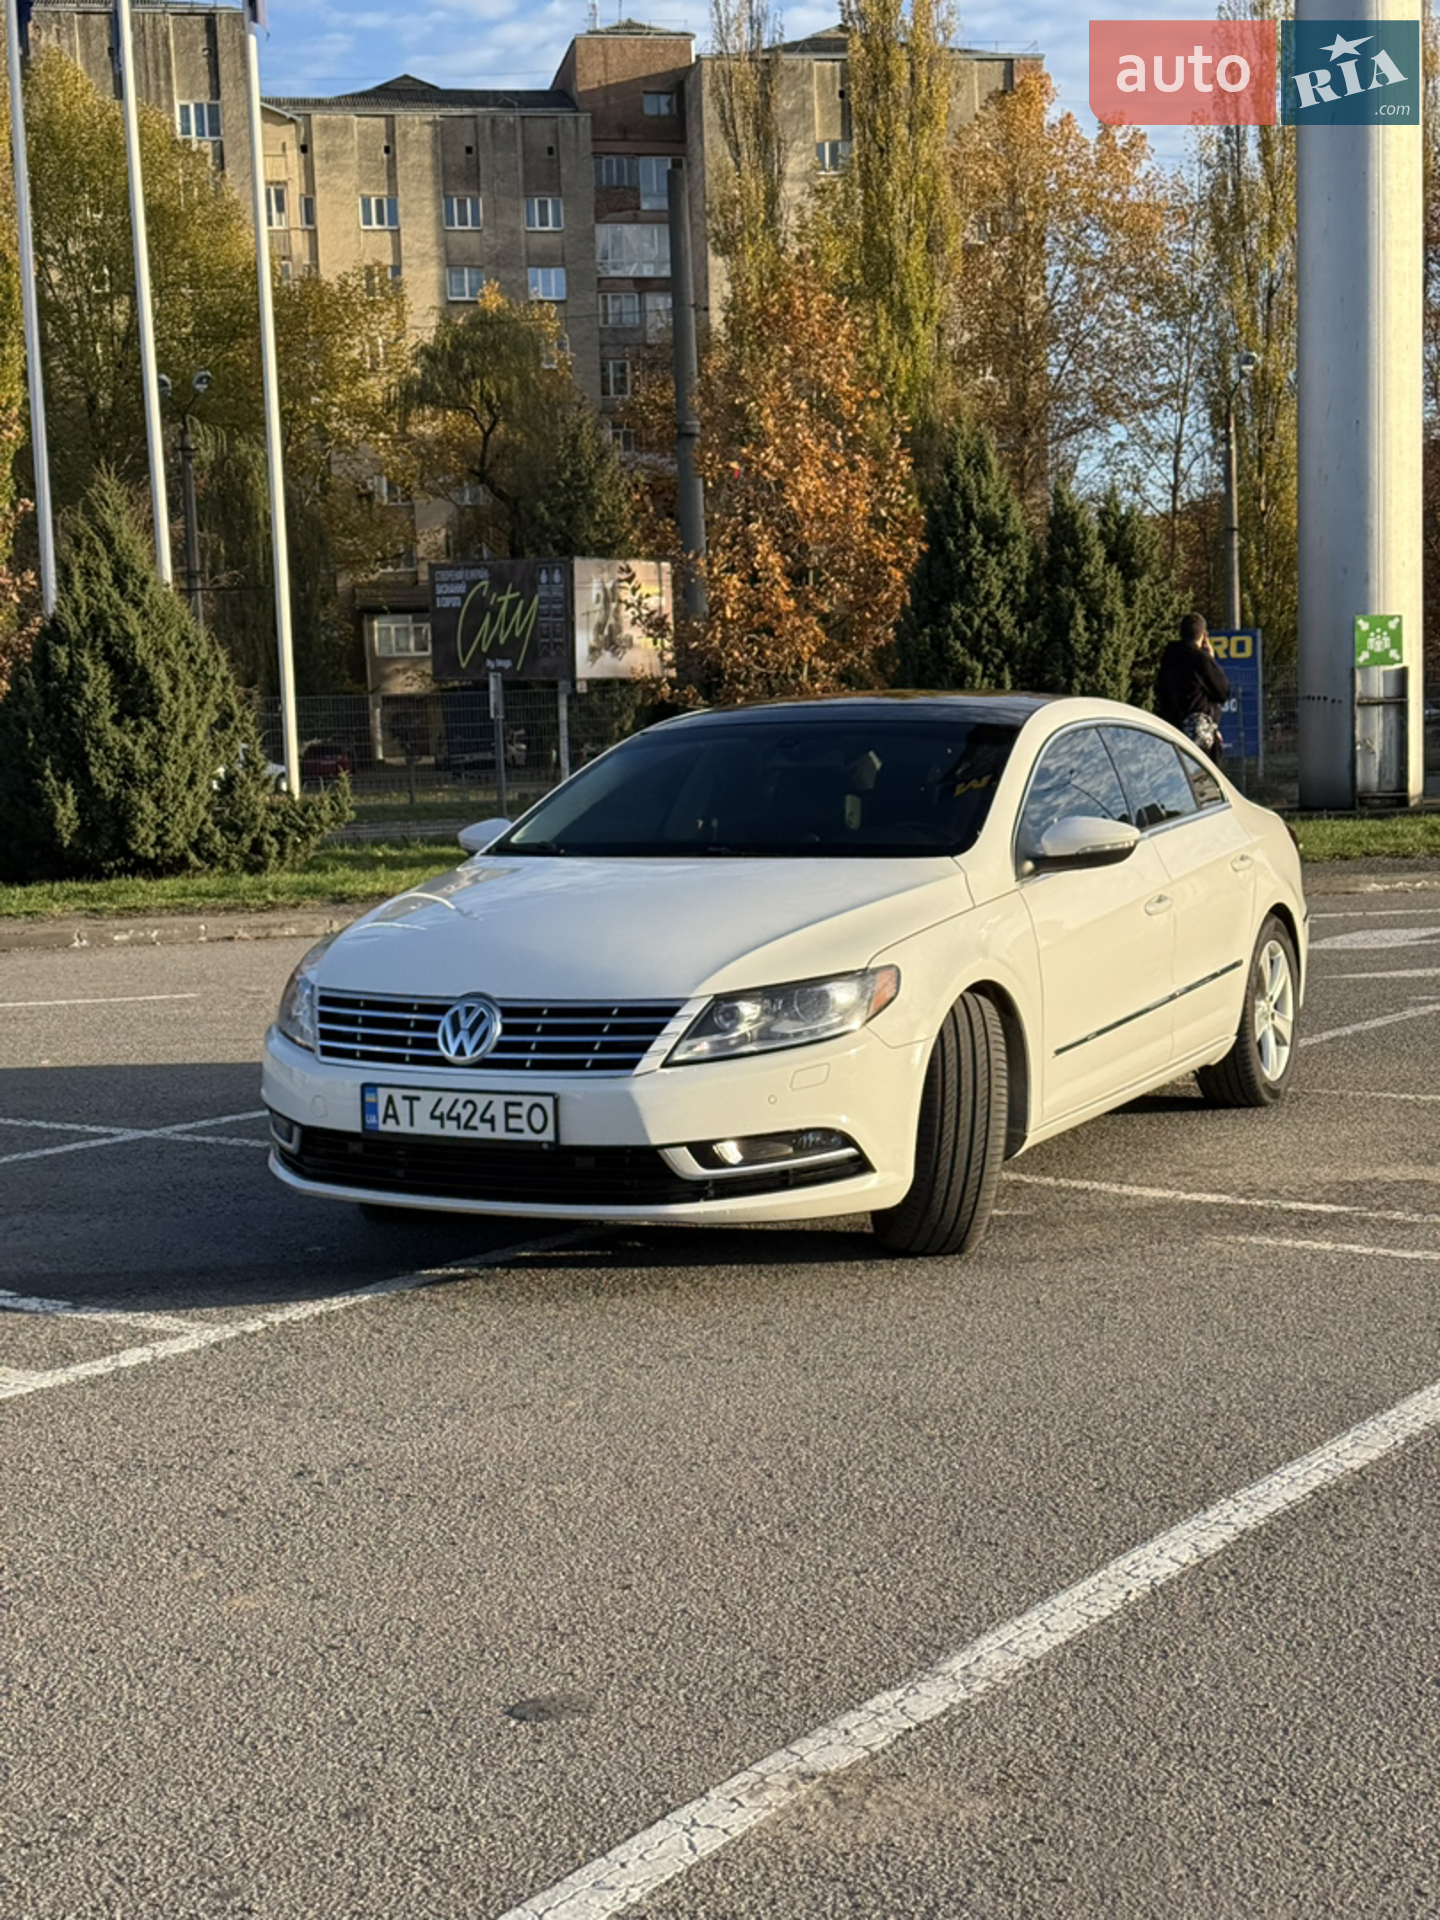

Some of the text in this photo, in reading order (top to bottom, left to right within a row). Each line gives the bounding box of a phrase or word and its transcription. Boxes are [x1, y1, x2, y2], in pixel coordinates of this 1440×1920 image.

[457, 580, 540, 670] City
[365, 1113, 378, 1124] UA
[382, 1094, 549, 1135] AT 4424 EO
